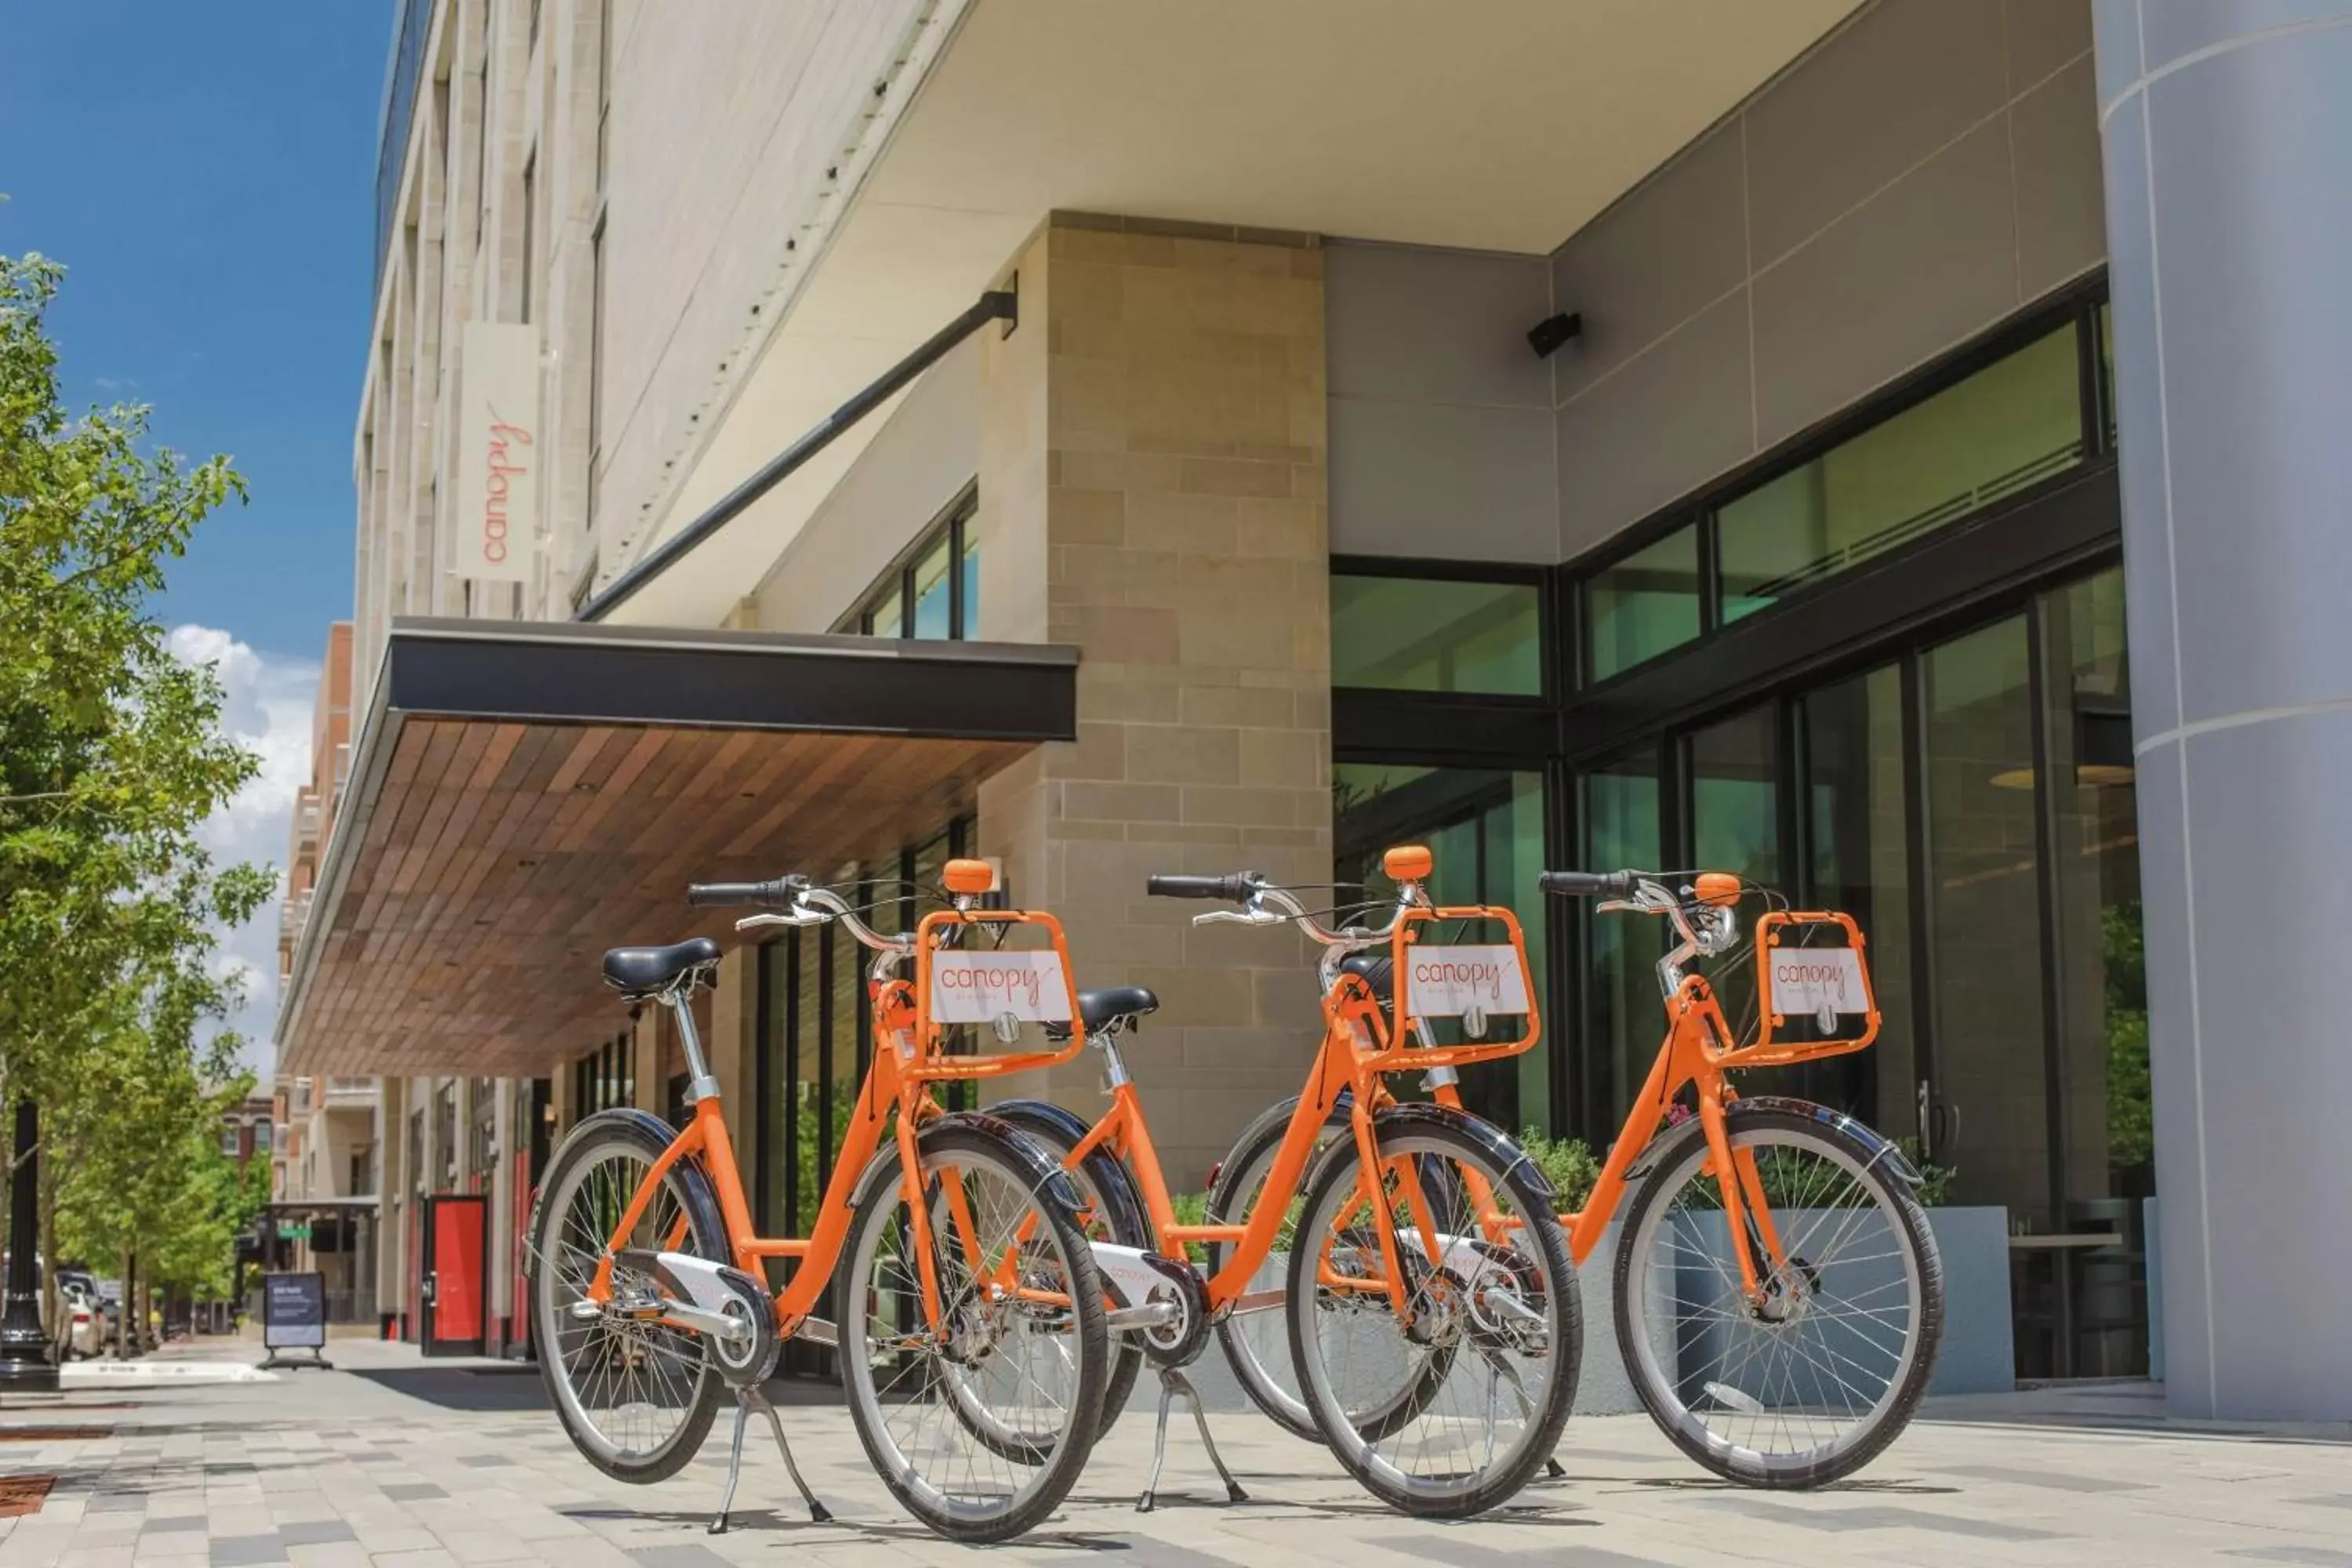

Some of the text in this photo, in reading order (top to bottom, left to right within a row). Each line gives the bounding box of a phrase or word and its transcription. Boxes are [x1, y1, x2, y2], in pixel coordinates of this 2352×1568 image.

[484, 400, 533, 563] canopy
[941, 967, 1054, 1007] canopy
[1415, 960, 1513, 1001] canopy
[1777, 964, 1854, 1001] canopy
